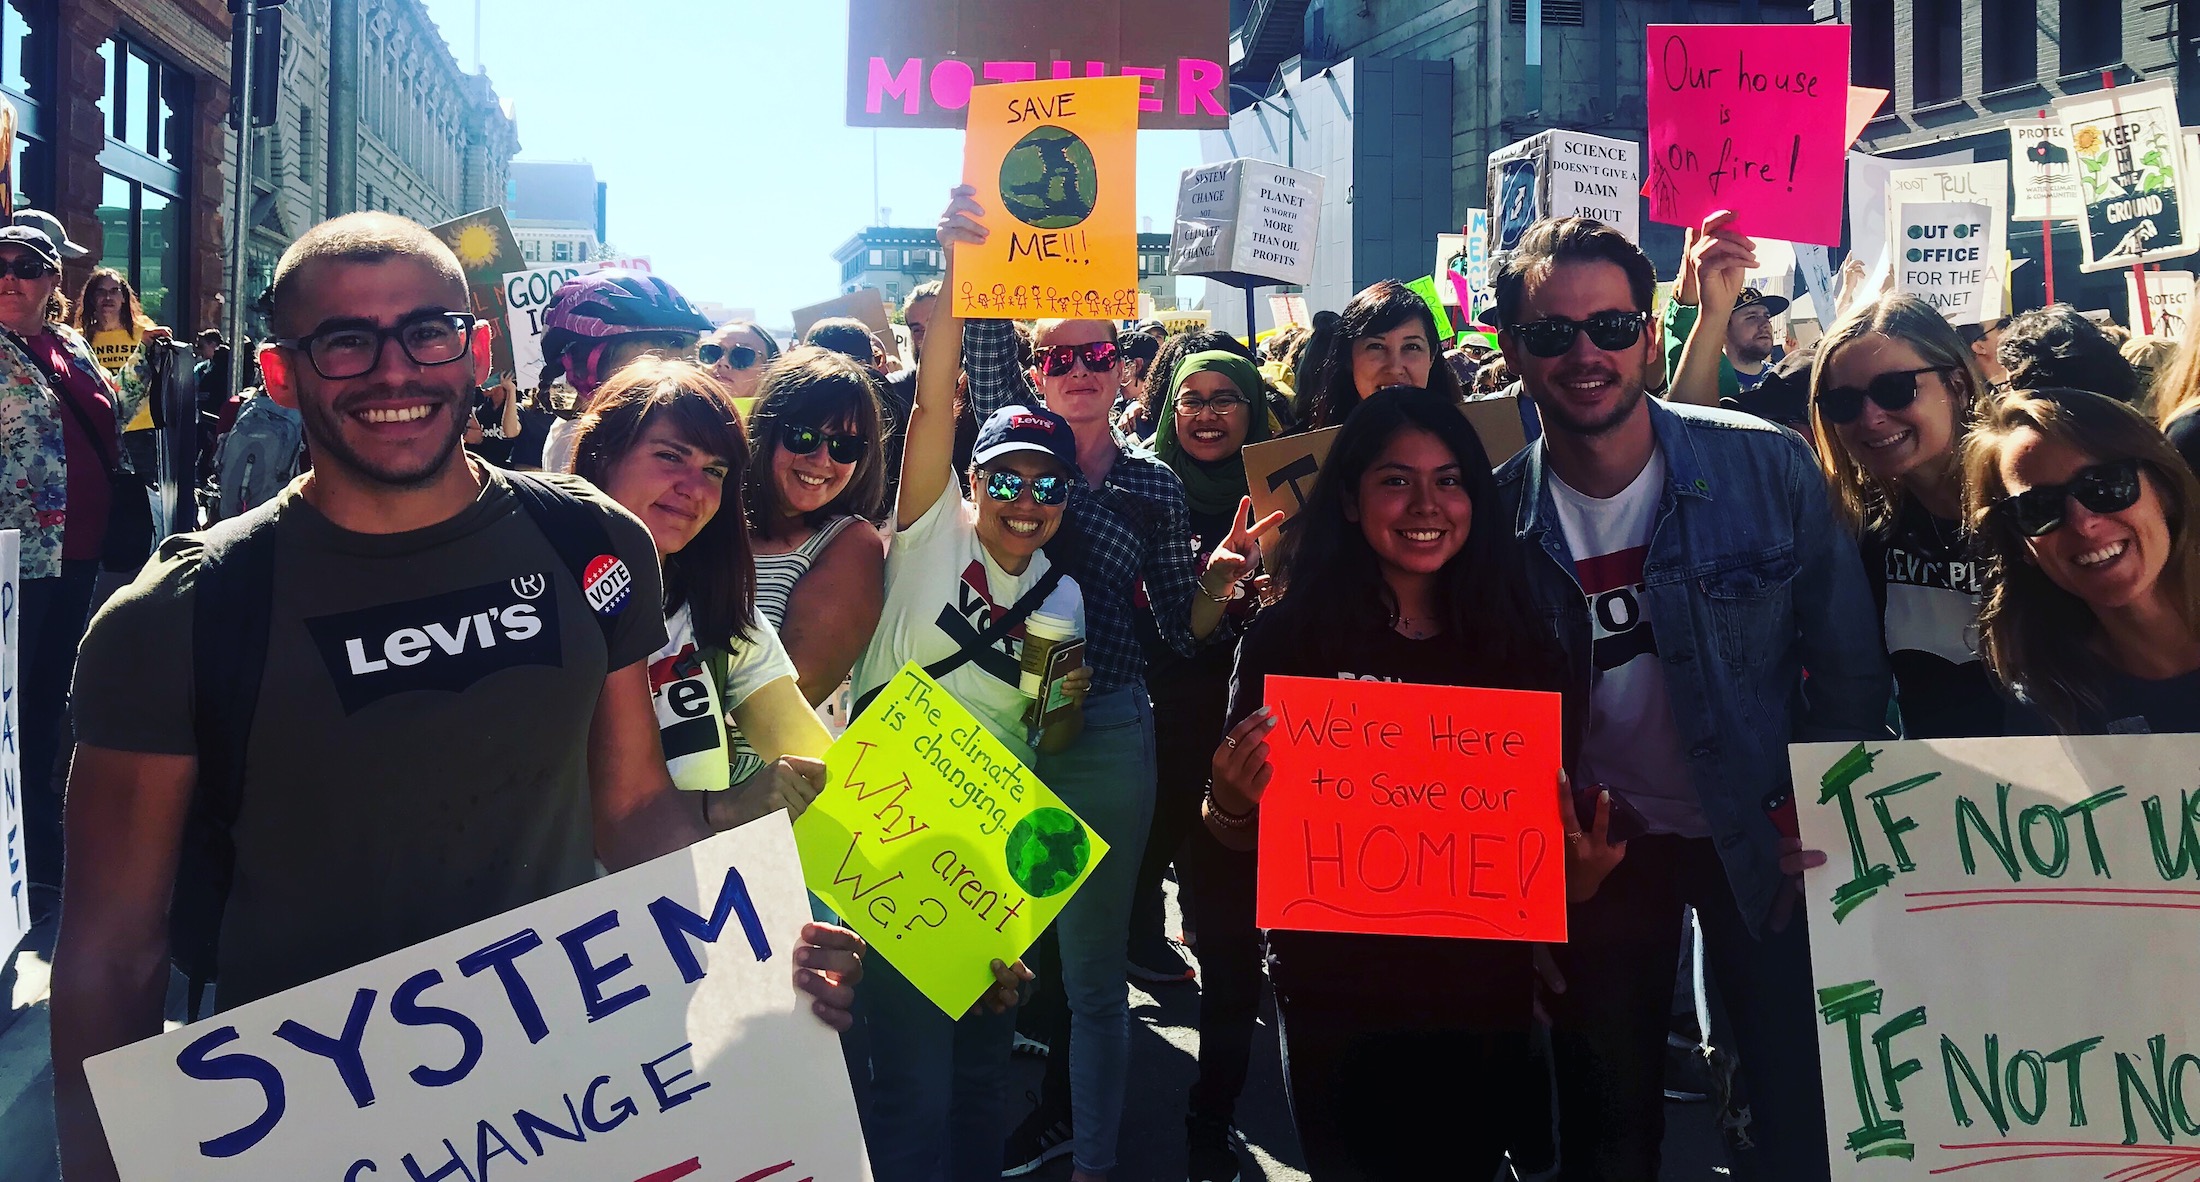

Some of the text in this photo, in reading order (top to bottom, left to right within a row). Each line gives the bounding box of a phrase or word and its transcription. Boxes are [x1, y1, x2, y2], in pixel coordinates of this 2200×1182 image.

[1664, 35, 1818, 97] Our house
[1007, 92, 1076, 124] SAVE
[1720, 104, 1731, 125] is
[2018, 127, 2064, 138] PROTEC
[2102, 123, 2140, 148] KEEP
[1564, 141, 1627, 162] SCIENCE
[1553, 161, 1637, 181] DOESN'T GIVE A
[1709, 135, 1800, 196] fire!
[1195, 171, 1226, 185] SYSTEM
[1274, 175, 1296, 188] OUR
[2117, 172, 2139, 186] THE
[1192, 190, 1225, 204] CHANGE
[1260, 188, 1305, 208] PLANET
[1574, 181, 1618, 197] DAMN
[1263, 205, 1297, 220] IS WORTH
[1572, 206, 1622, 223] ABOUT
[2106, 195, 2163, 224] GROUND
[1263, 218, 1294, 234] MORE
[1907, 223, 1981, 240] OUT OF
[1008, 229, 1090, 265] ME!!!
[1183, 245, 1216, 259] CHANGE
[1252, 231, 1300, 252] THAN OIL
[1253, 248, 1296, 267] PROFITS
[1906, 247, 1979, 263] OFFICE
[1907, 269, 1981, 285] FOR THE
[2148, 293, 2187, 305] ROTECT
[590, 563, 630, 605] VOTE
[905, 671, 1025, 803] The climate
[1280, 698, 1525, 757] We're Here
[881, 701, 1010, 835] is changing...
[1311, 768, 1355, 800] to
[1461, 785, 1518, 812] our
[844, 741, 1025, 933] Why aren't
[1817, 741, 1942, 925] IF
[1954, 783, 2128, 882] NOT
[1303, 819, 1547, 919] HOME!
[833, 832, 947, 939] We?
[177, 867, 773, 1158] SYSTEM
[1817, 979, 1927, 1163] IF
[1940, 1033, 2105, 1137] NOT
